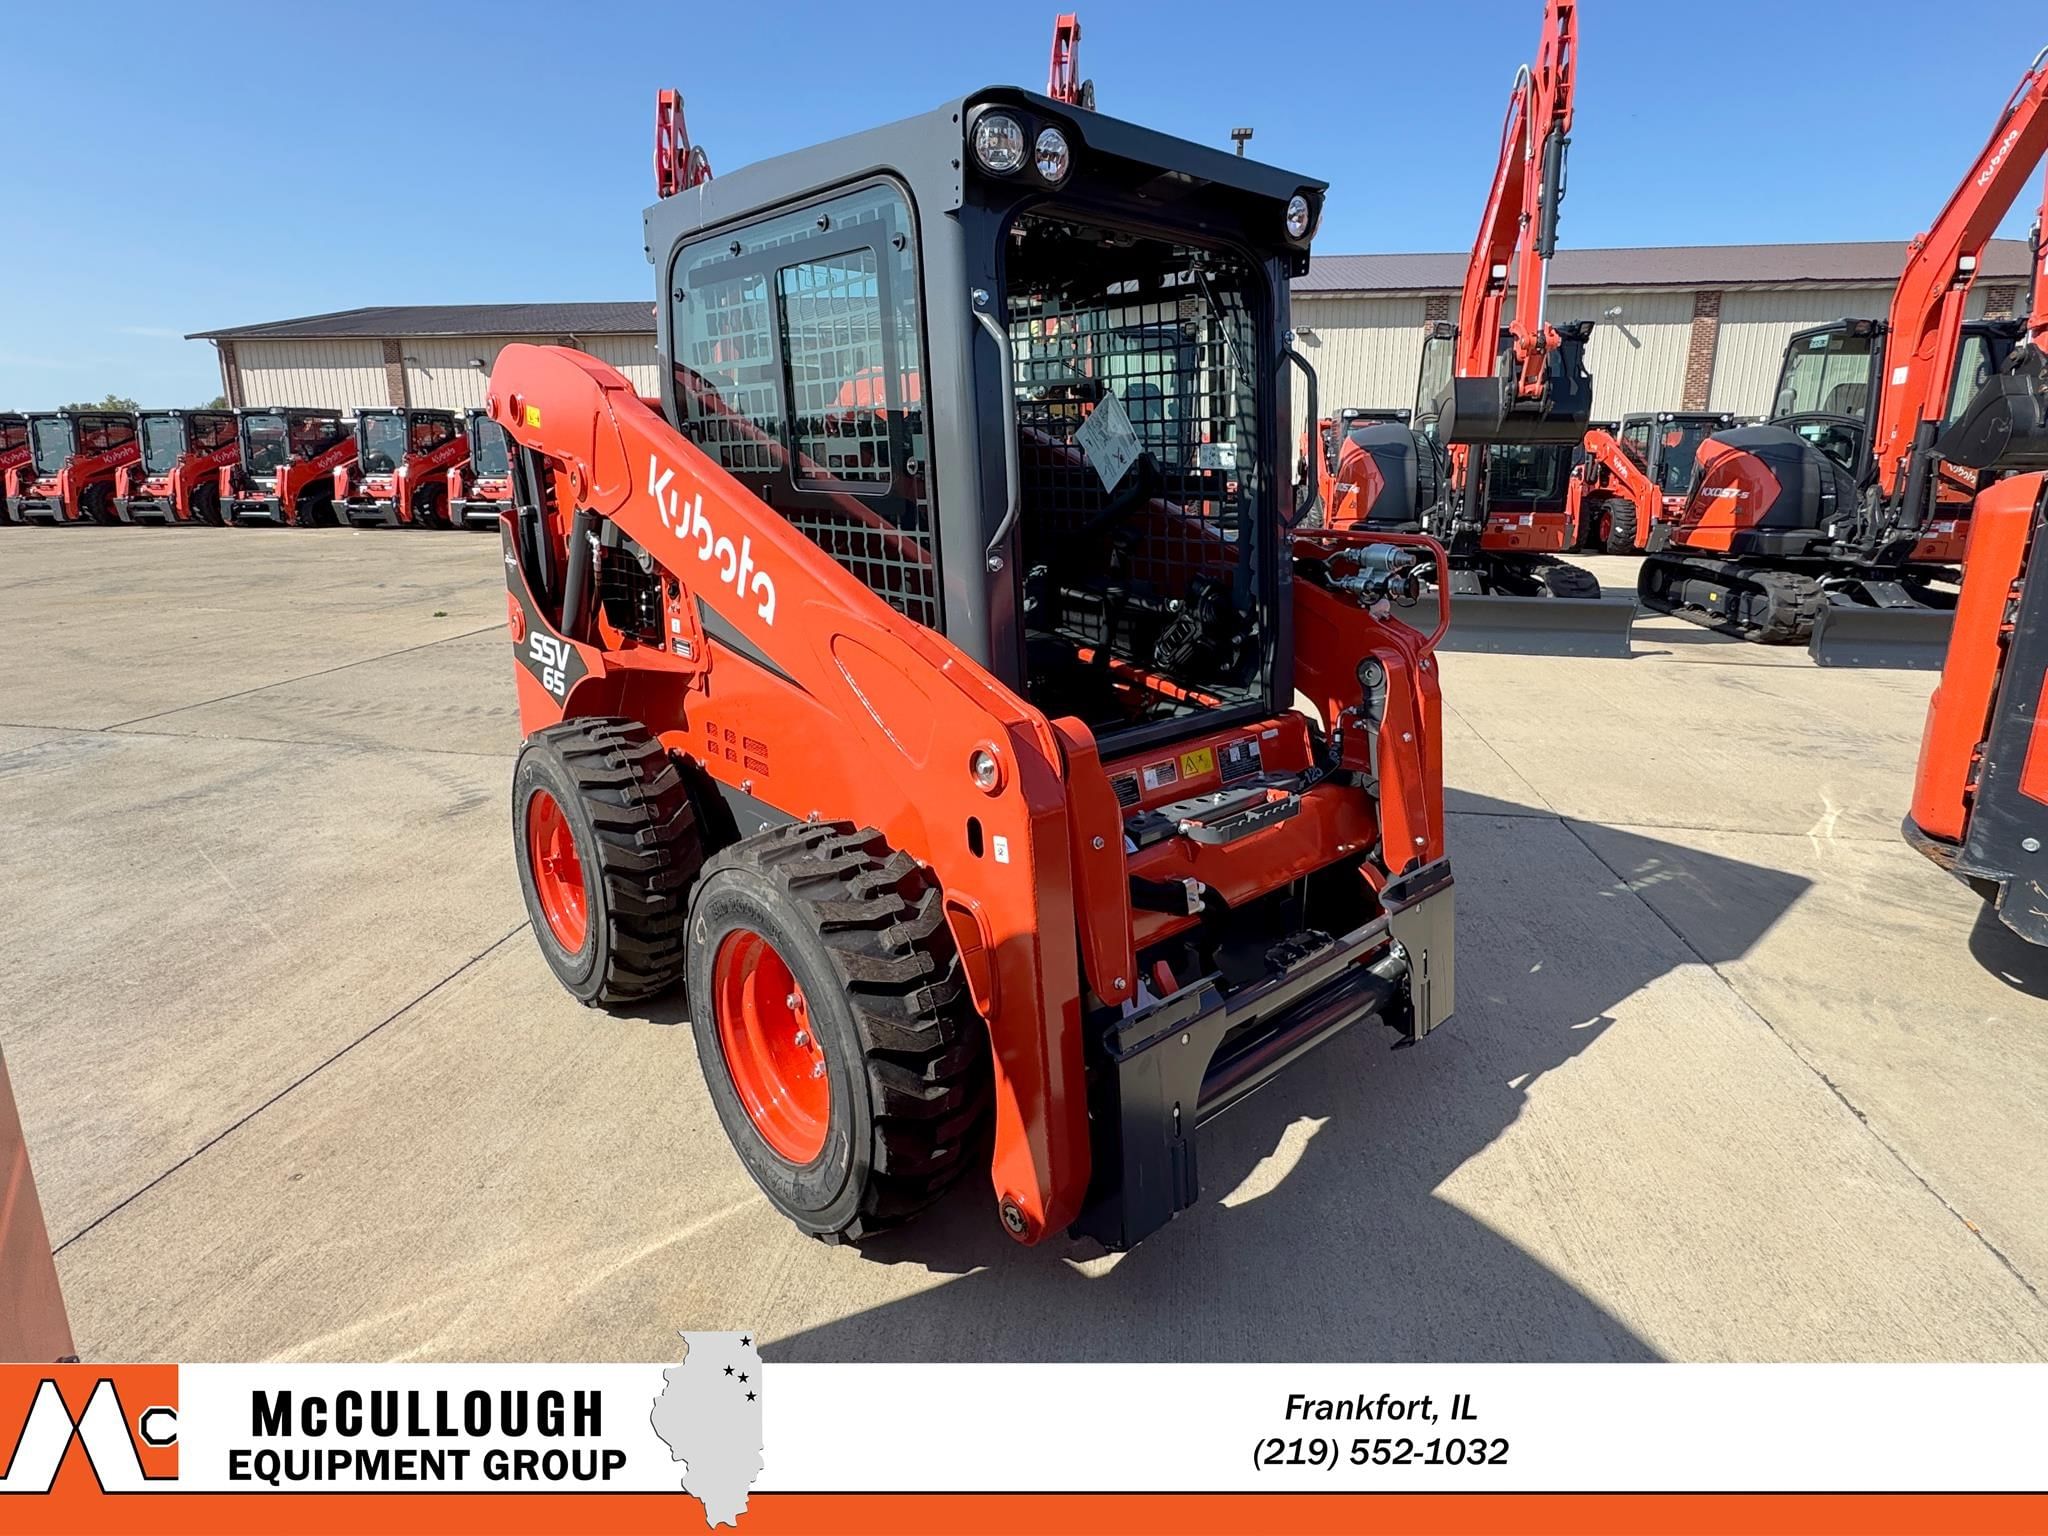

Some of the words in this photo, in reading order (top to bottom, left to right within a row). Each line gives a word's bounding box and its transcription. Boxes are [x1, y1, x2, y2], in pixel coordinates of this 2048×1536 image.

[1977, 130, 2019, 186] Kubota
[103, 447, 134, 464] Kubota
[317, 450, 343, 468] Kubota
[431, 447, 456, 464] Kubota
[647, 453, 776, 627] Kubota
[529, 631, 571, 672] SSV
[542, 665, 568, 697] 65
